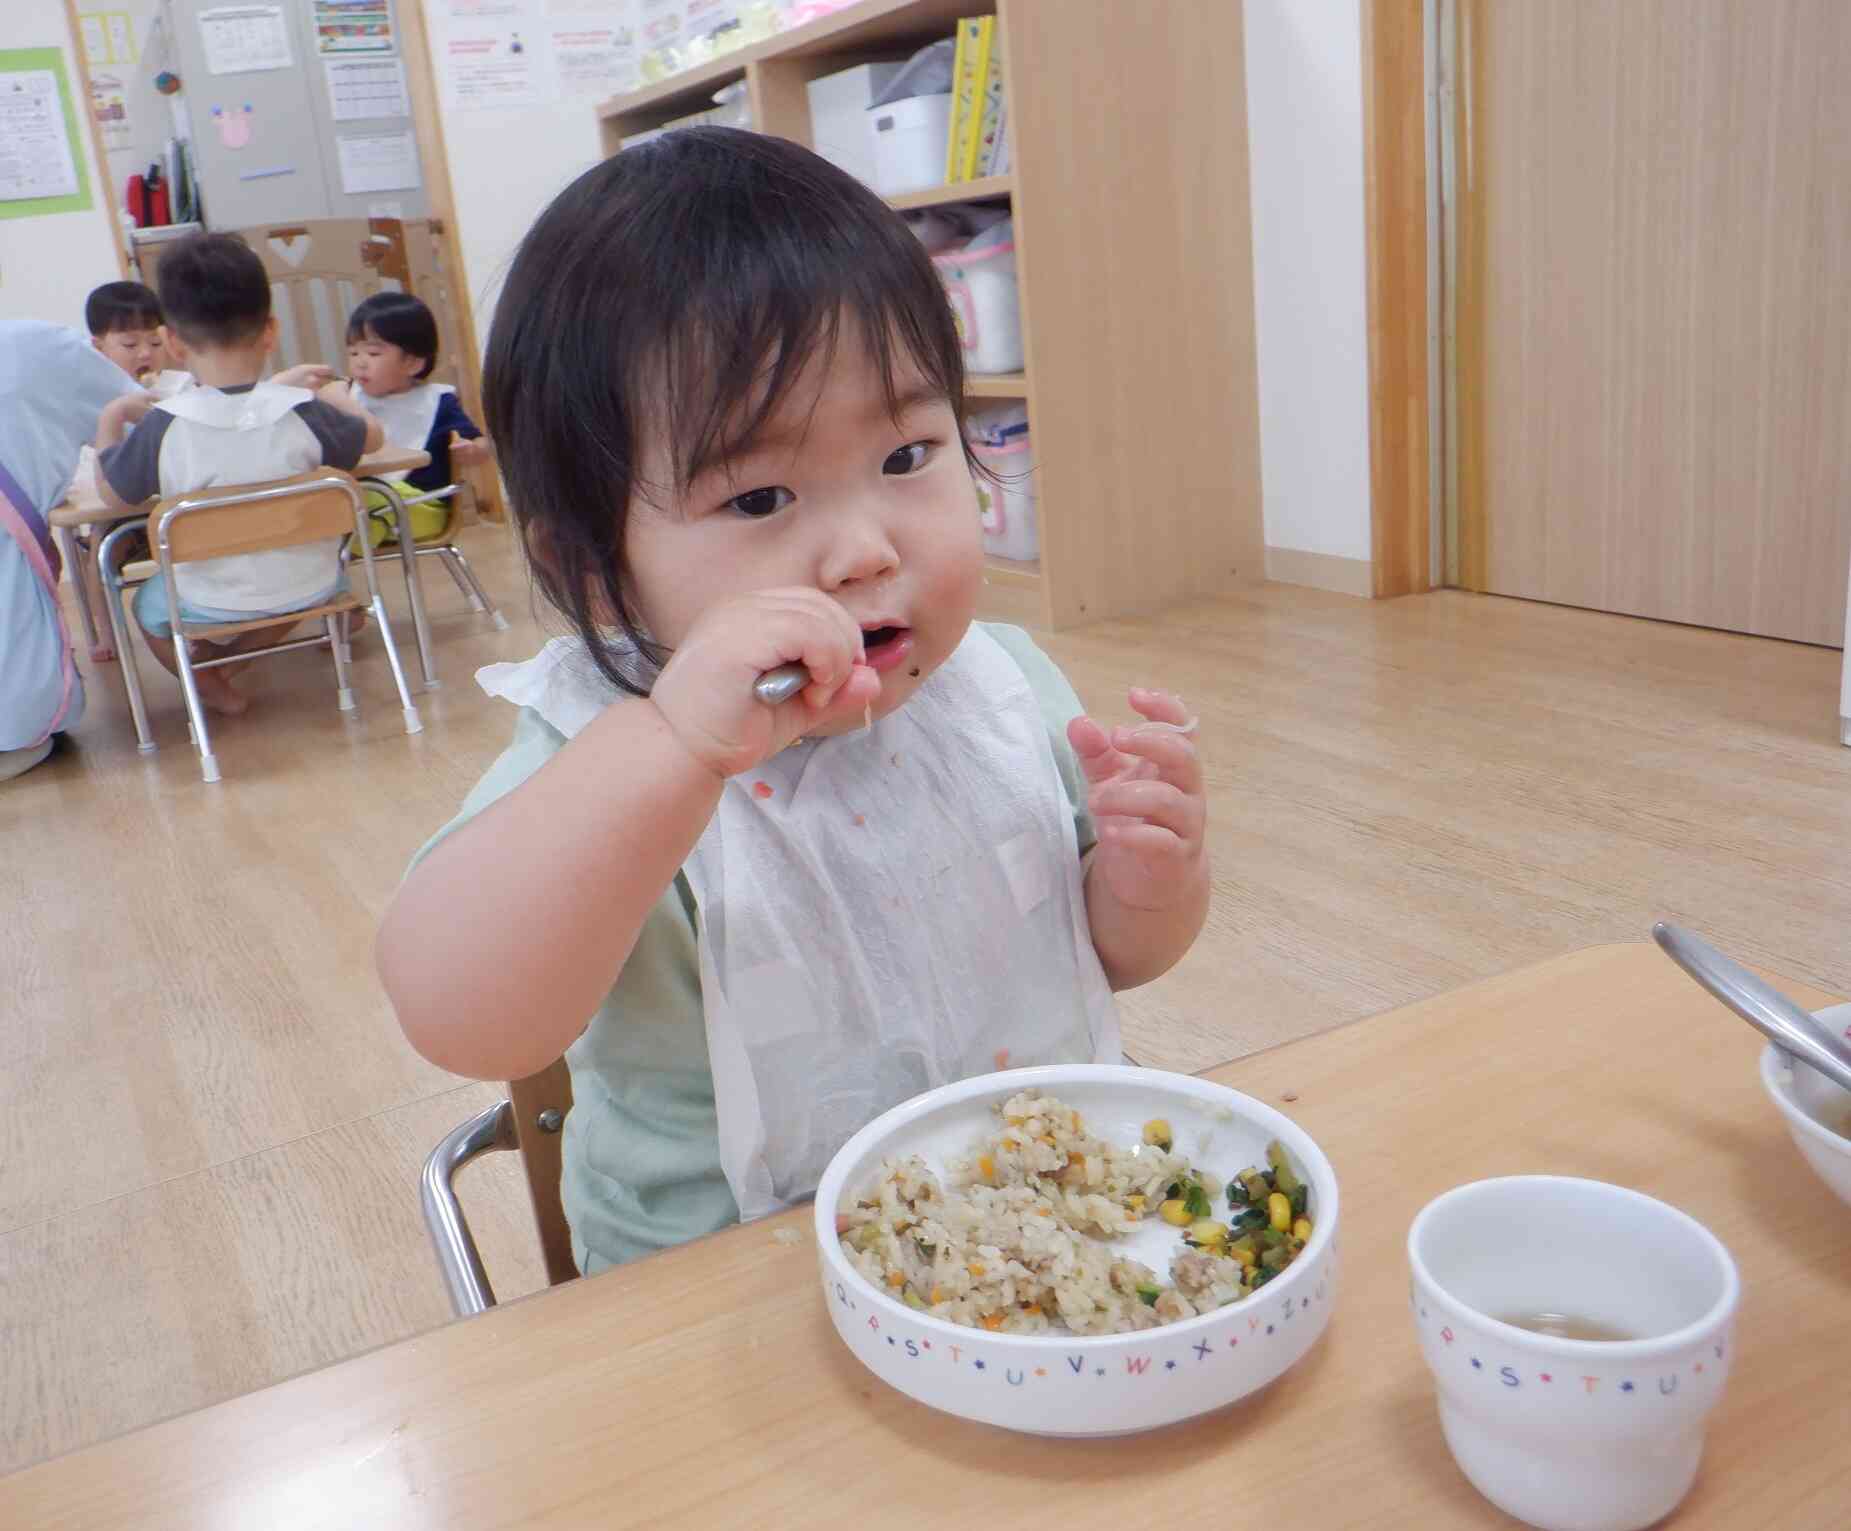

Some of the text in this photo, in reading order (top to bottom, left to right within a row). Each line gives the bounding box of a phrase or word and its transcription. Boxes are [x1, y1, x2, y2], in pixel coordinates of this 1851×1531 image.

[905, 1339, 919, 1357] S
[949, 1344, 961, 1363] T
[1006, 1368, 1024, 1386] U
[1068, 1355, 1084, 1374] V
[1126, 1355, 1151, 1374] W
[1192, 1338, 1212, 1360] X
[1501, 1366, 1519, 1387] S
[1581, 1375, 1598, 1393] T
[1659, 1375, 1677, 1396] U
